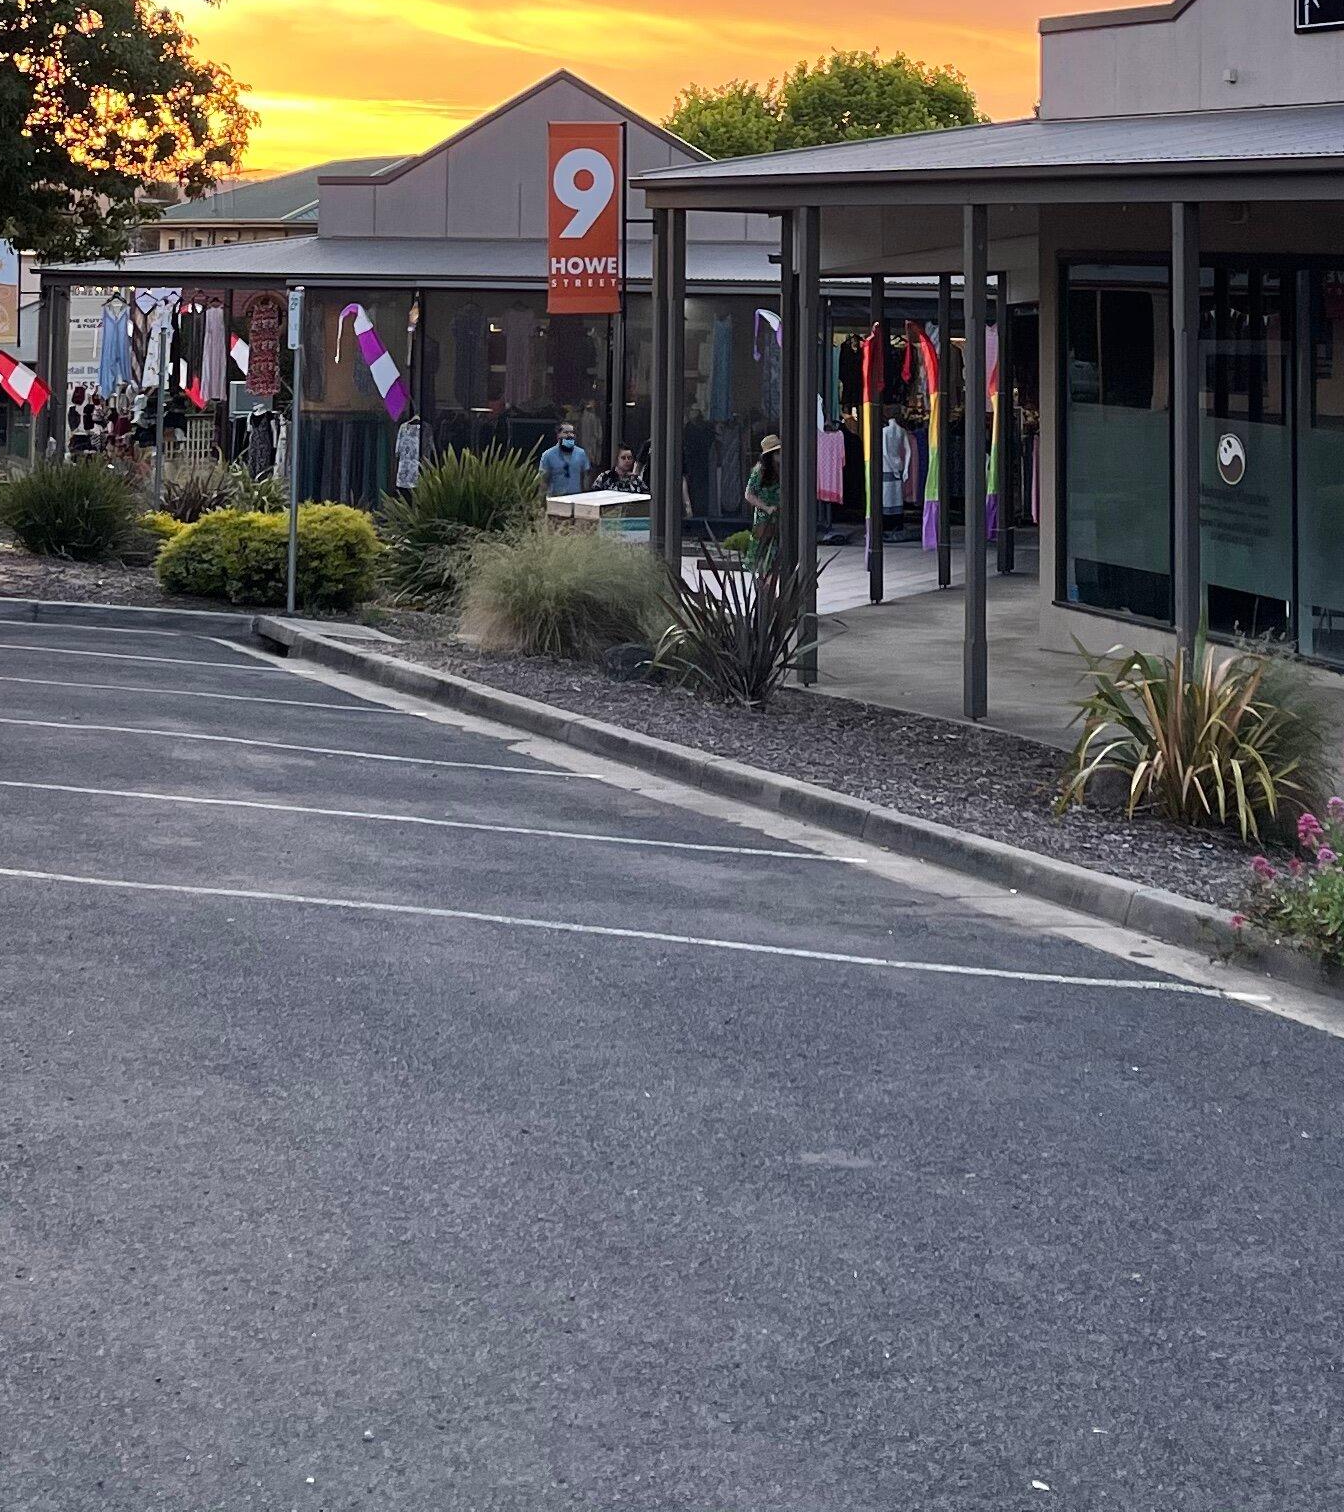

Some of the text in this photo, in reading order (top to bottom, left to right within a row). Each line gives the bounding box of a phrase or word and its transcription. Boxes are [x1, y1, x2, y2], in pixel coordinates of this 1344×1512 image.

[553, 148, 615, 239] 9
[551, 256, 617, 274] HOWE
[551, 278, 617, 287] STREET
